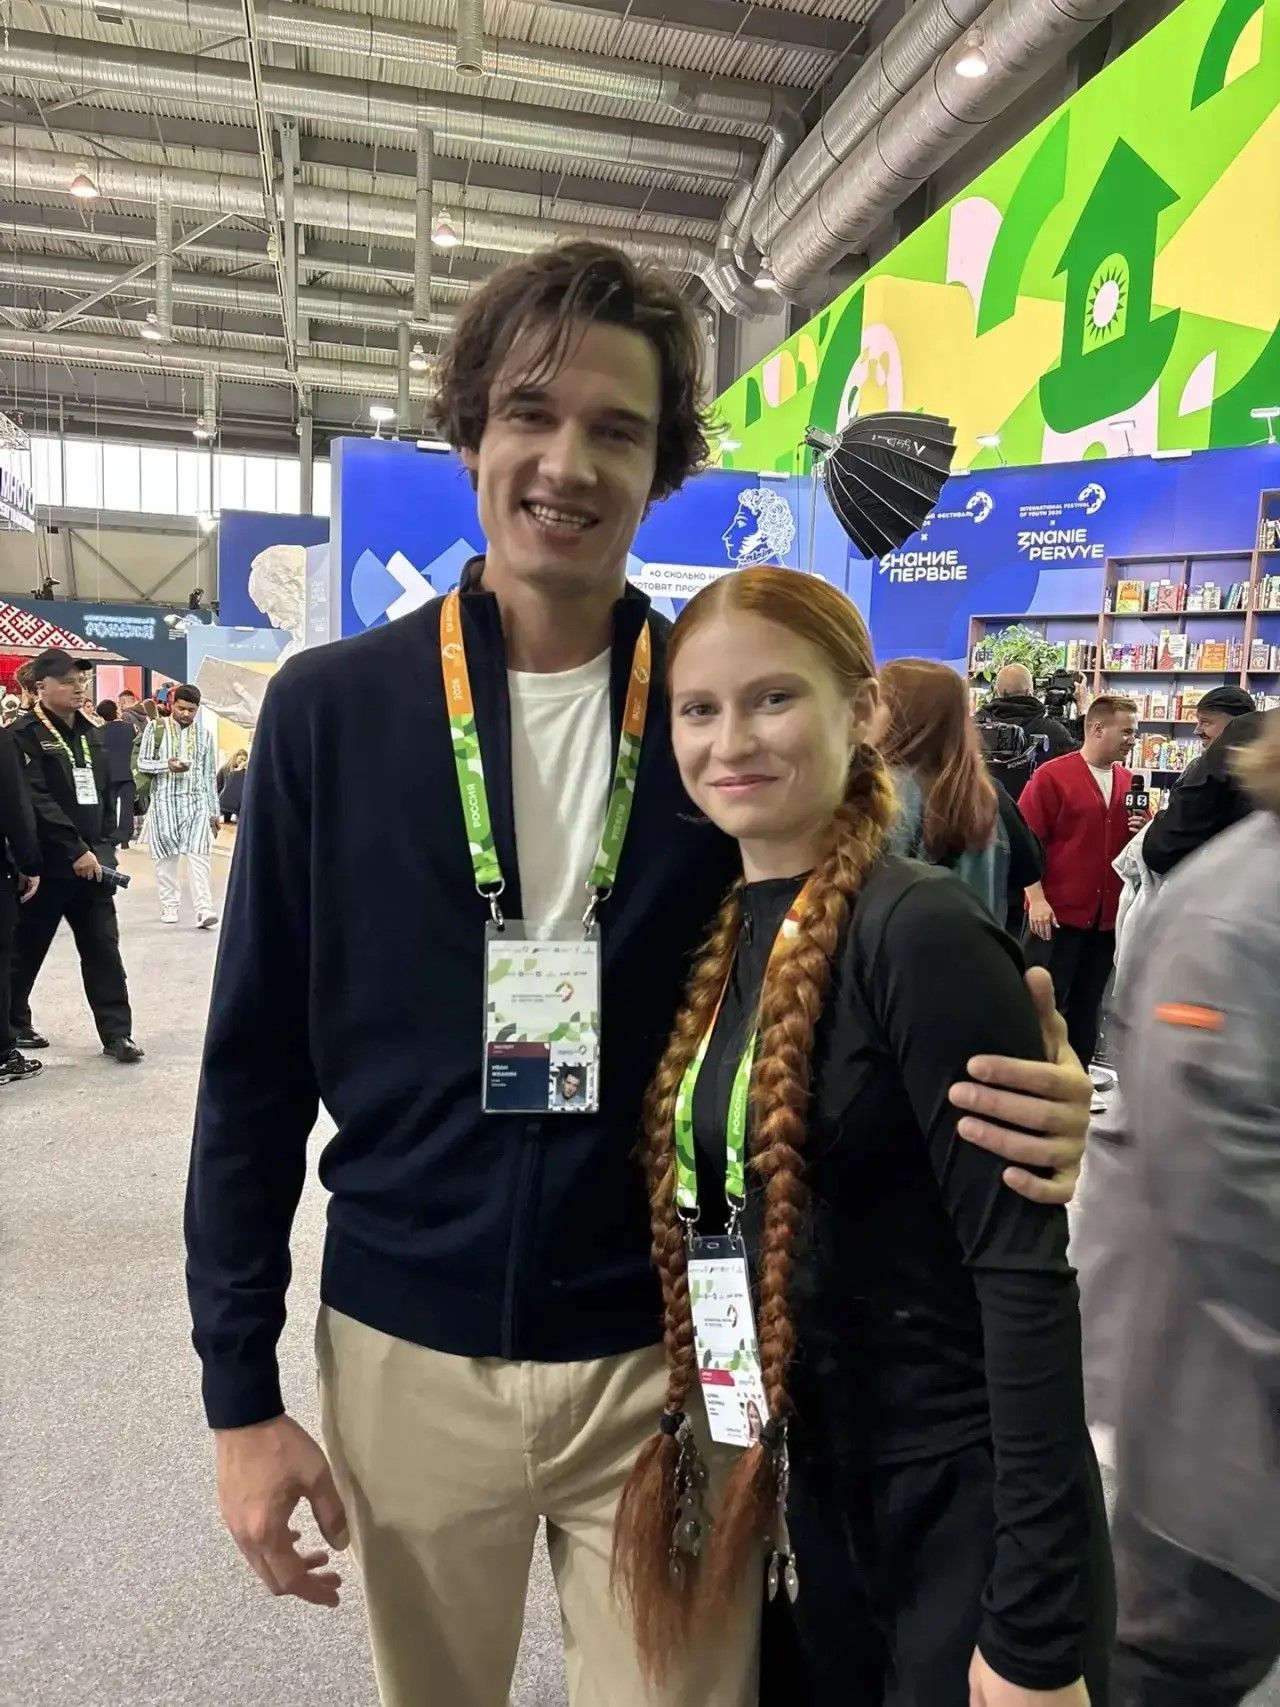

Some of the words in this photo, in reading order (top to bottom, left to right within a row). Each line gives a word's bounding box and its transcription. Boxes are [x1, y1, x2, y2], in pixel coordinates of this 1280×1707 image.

[1019, 503, 1063, 512] INTERNATIONAL
[1064, 501, 1090, 509] FESTIVAL
[937, 511, 974, 519] ФЕСТИВАЛЬ
[1029, 543, 1105, 561] PERVYE
[664, 570, 706, 581] СКОЛЬКО
[889, 565, 968, 583] ПЕРВЫЕ
[466, 783, 482, 828] РОССИЯ
